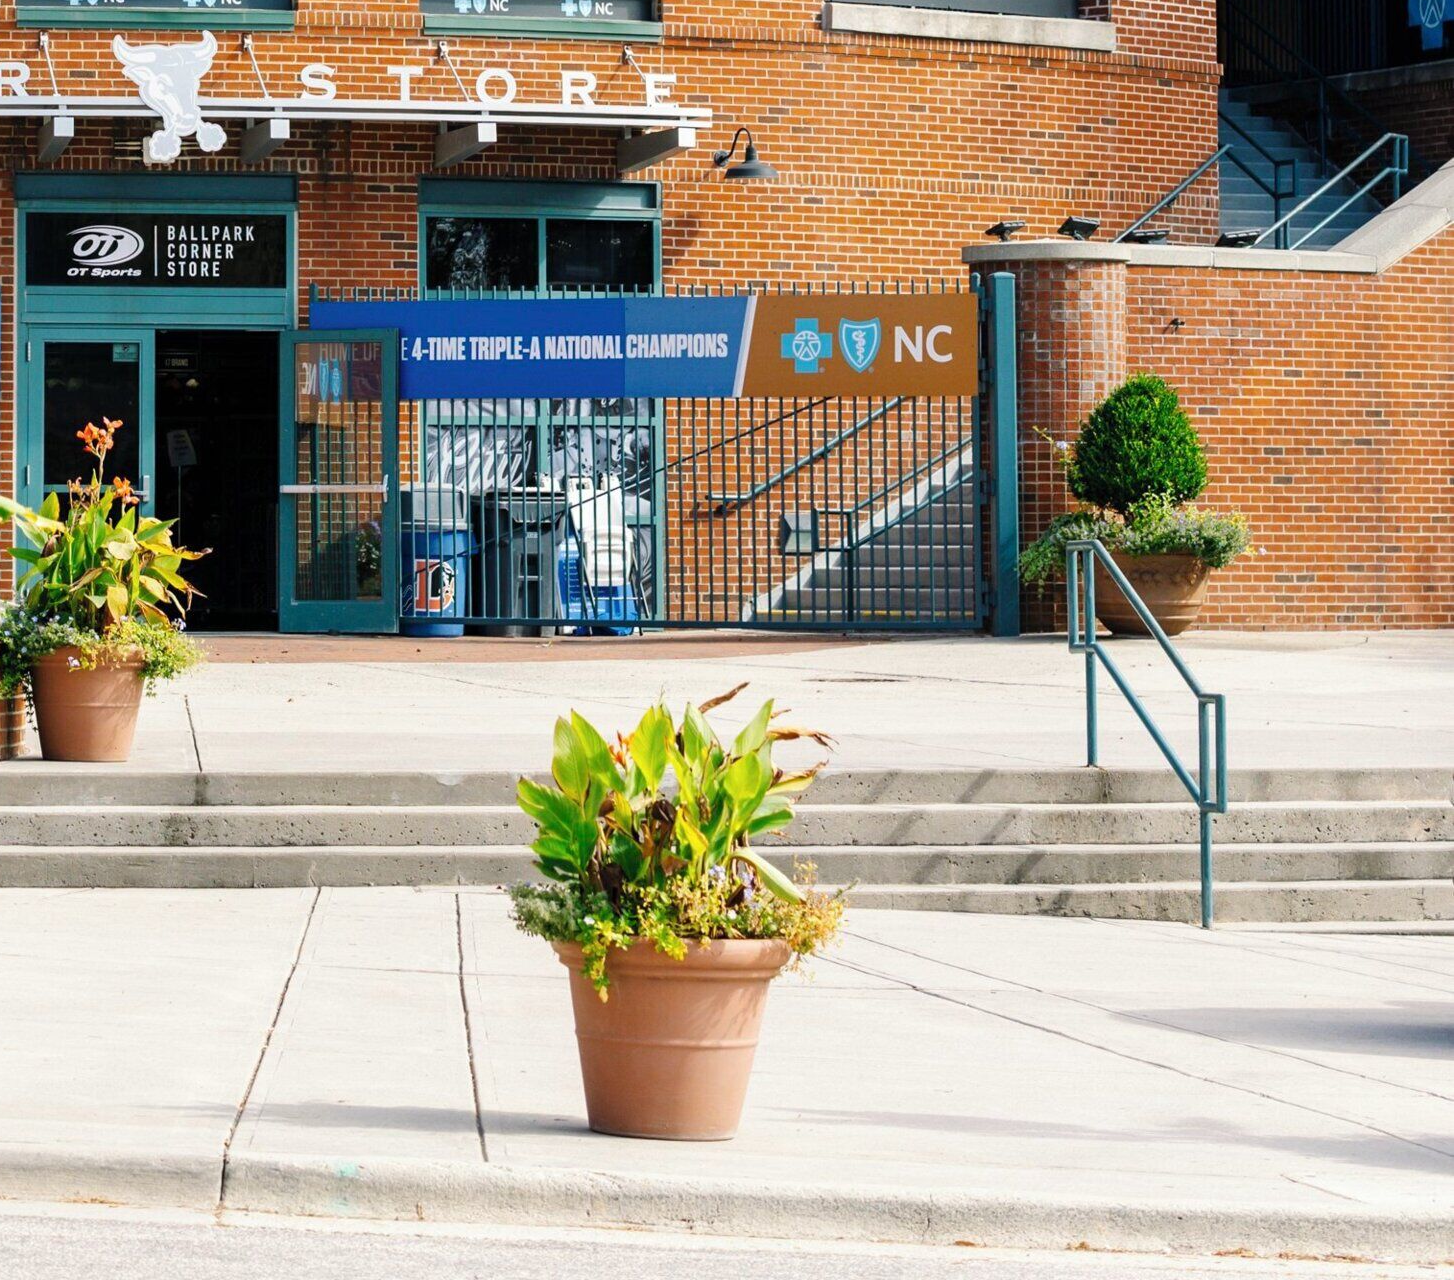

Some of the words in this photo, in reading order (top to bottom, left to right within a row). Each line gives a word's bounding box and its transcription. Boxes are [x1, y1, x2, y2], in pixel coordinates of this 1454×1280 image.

[595, 2, 614, 16] NC
[300, 64, 678, 108] STORE
[167, 225, 255, 241] BALLPARK
[72, 233, 126, 258] OT
[167, 243, 234, 259] CORNER
[67, 268, 89, 277] OT
[91, 267, 142, 278] Sports
[167, 261, 221, 277] STORE
[319, 342, 359, 362] HOME
[364, 342, 381, 361] OF
[411, 337, 466, 362] 4-TIME
[469, 336, 541, 361] TRIPLE-A
[544, 335, 624, 360] NATIONAL
[625, 333, 729, 359] CHAMPIONS
[894, 325, 953, 363] NC
